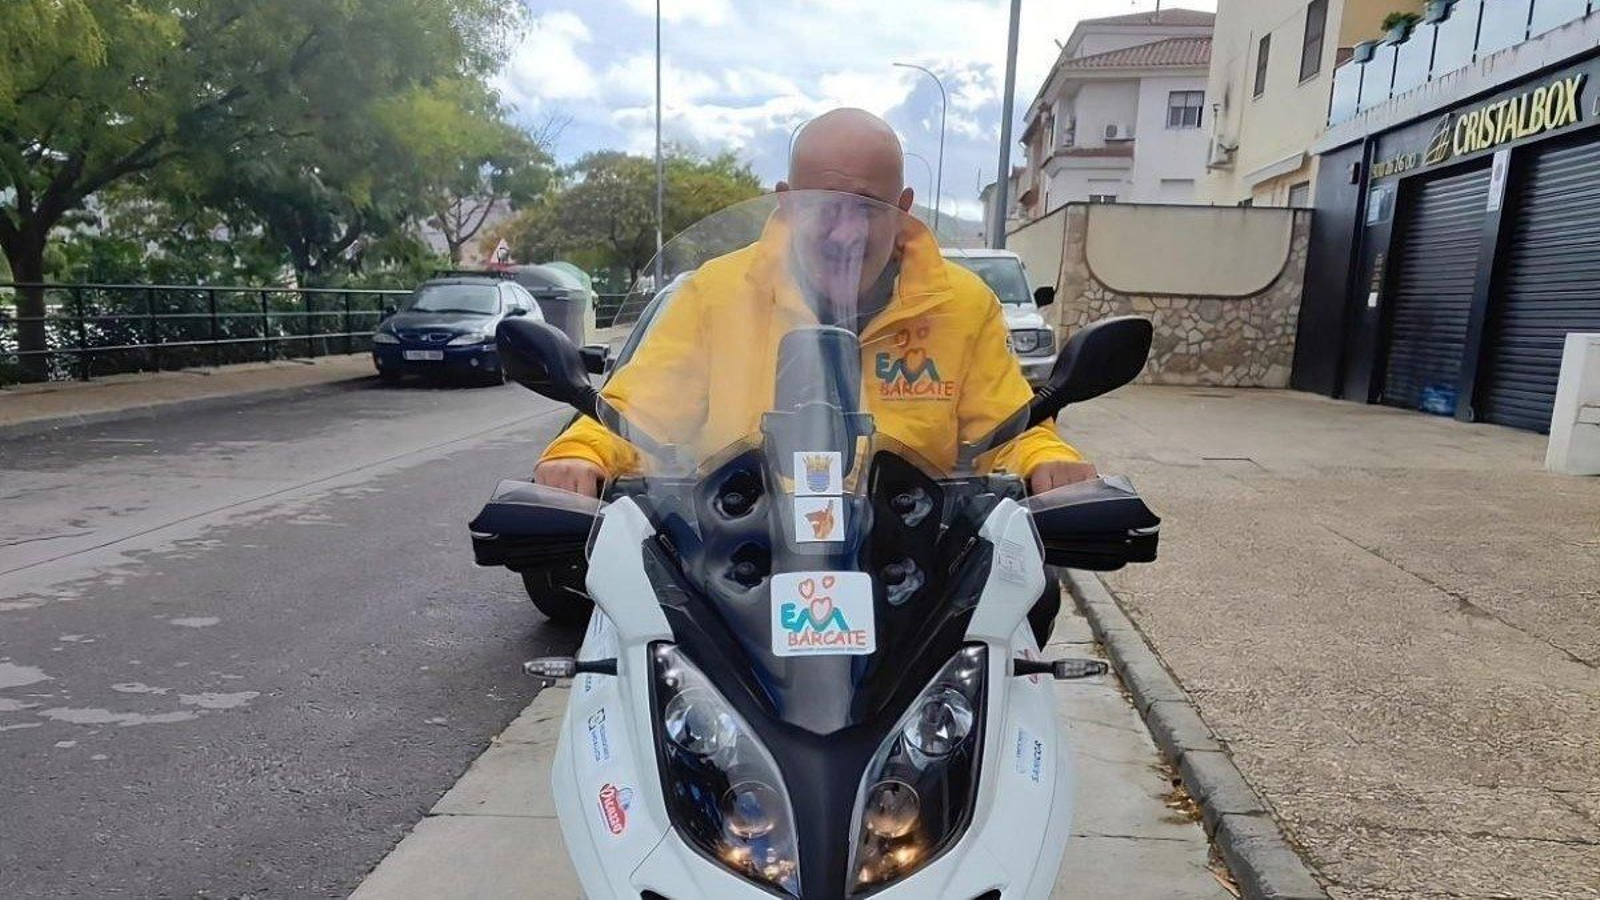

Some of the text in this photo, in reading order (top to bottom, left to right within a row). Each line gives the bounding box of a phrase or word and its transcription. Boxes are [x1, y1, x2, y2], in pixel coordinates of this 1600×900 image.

[1453, 73, 1582, 156] CRISTALBOX
[880, 380, 955, 397] BARCATE
[788, 629, 866, 647] BARCATE
